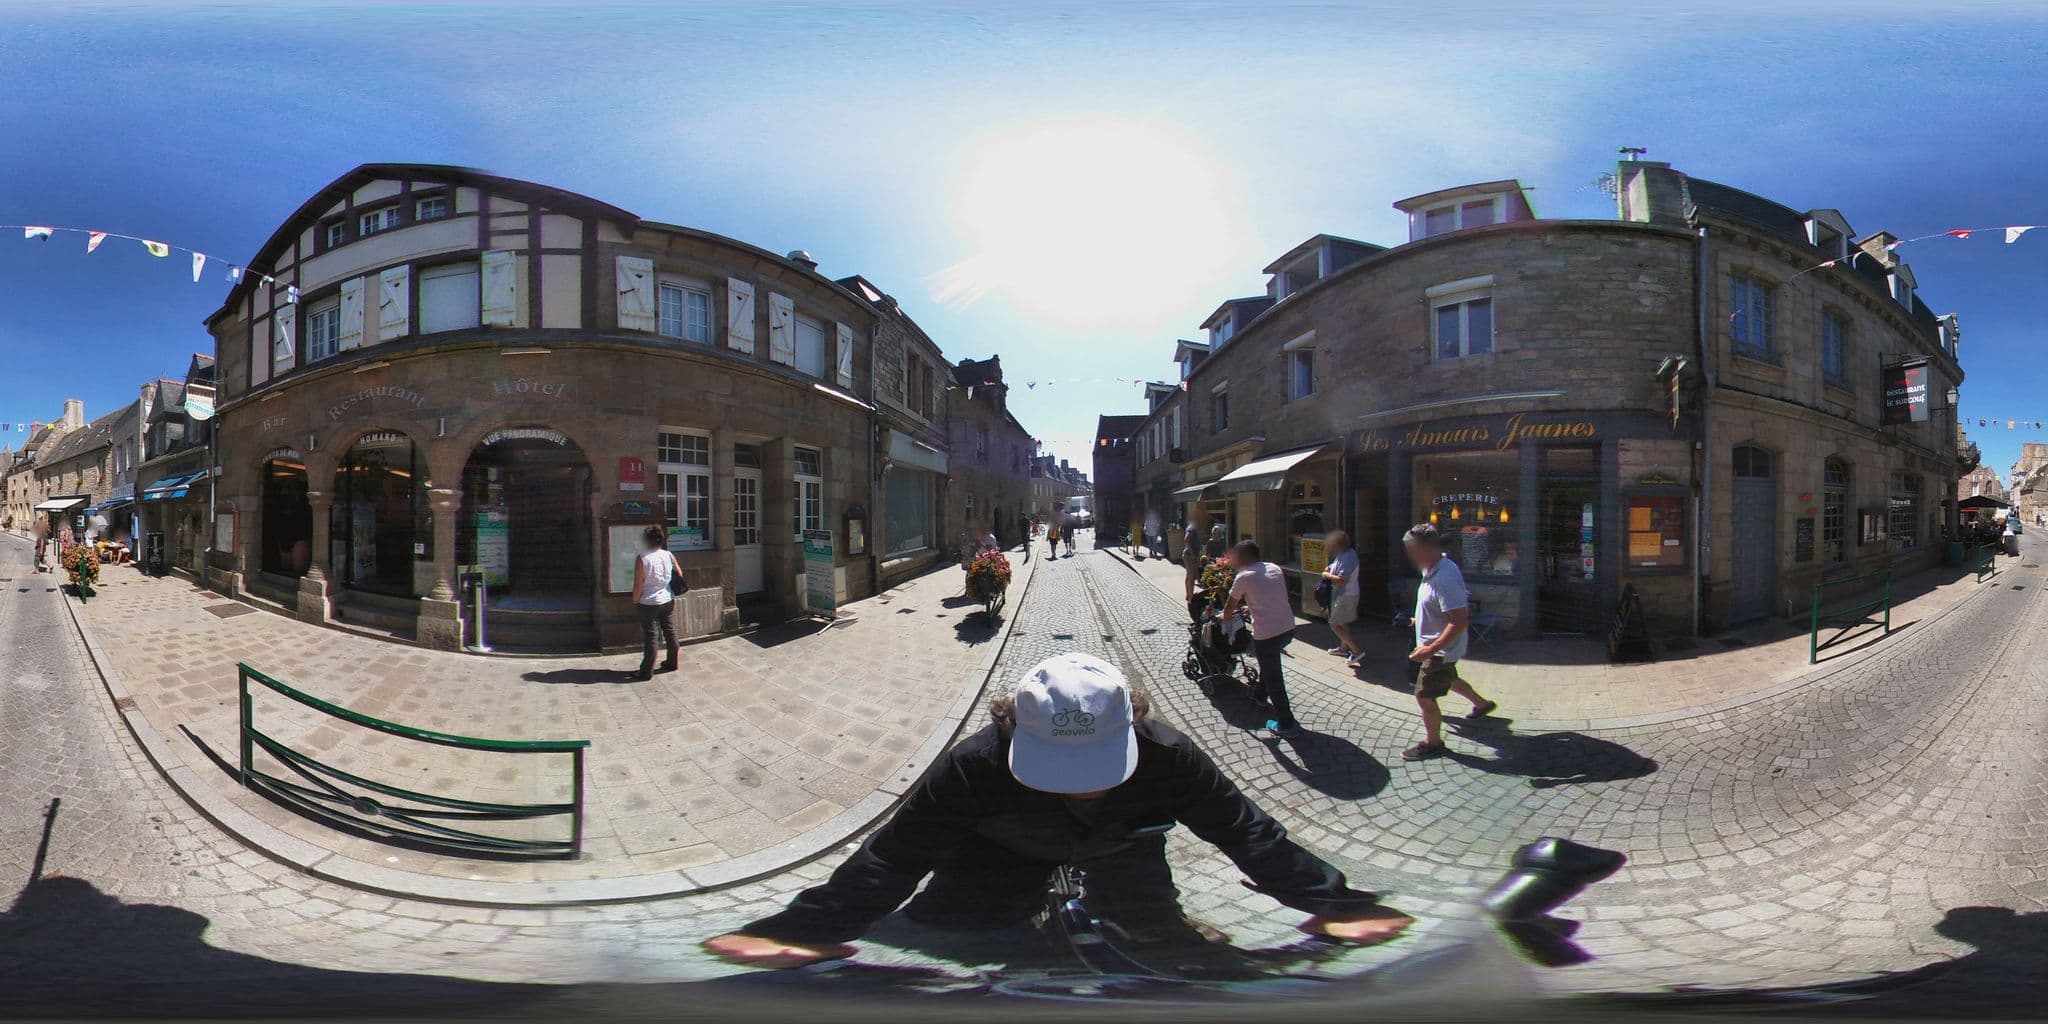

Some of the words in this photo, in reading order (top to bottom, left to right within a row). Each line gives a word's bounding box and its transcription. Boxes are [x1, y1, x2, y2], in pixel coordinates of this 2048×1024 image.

[495, 377, 566, 400] Hôtel
[328, 386, 425, 420] Restaurant
[263, 416, 287, 431] Bar
[1397, 424, 1489, 448] Amours
[1497, 411, 1596, 454] Jaunes
[482, 431, 501, 446] VUE
[502, 429, 568, 446] PANORAMIQUE
[1432, 493, 1498, 505] CREPERIE
